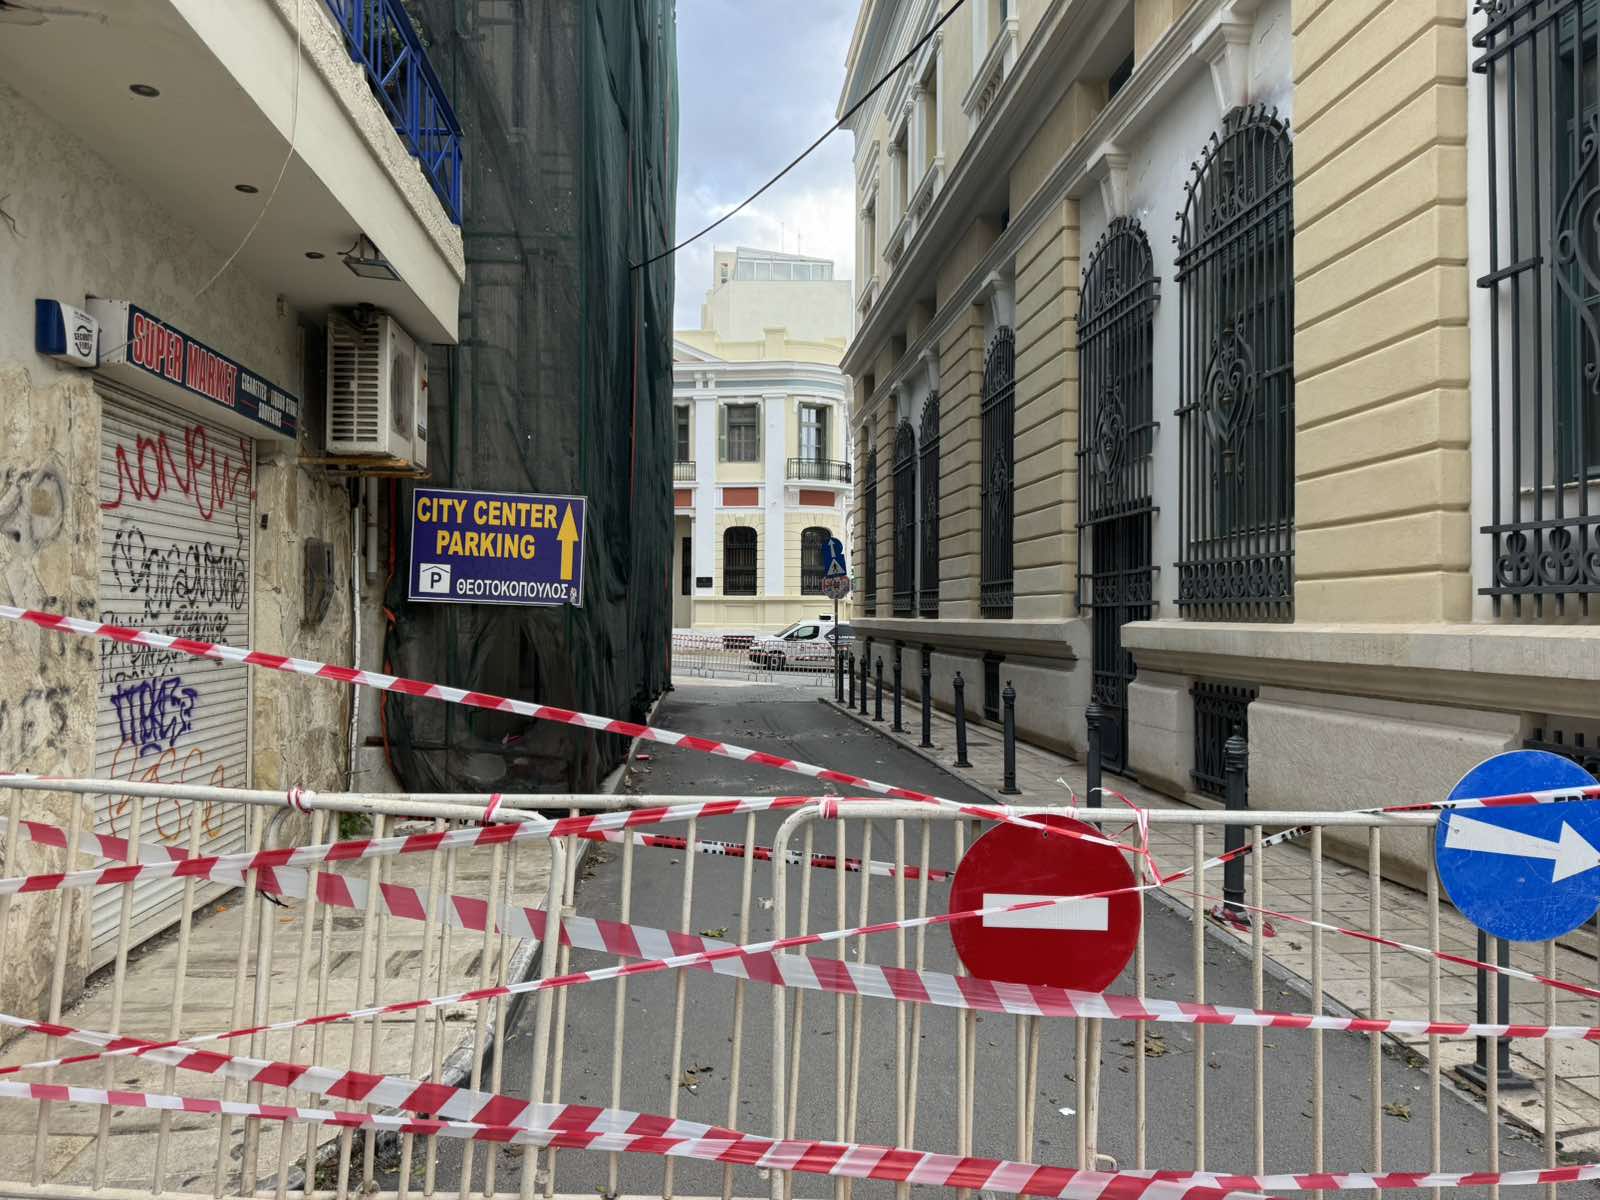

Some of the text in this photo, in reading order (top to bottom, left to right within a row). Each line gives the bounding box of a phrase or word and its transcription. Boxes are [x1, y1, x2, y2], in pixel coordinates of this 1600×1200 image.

[132, 312, 184, 384] SUPER
[186, 341, 238, 408] MARKET
[417, 496, 558, 529] CITY CENTER
[435, 530, 537, 560] PARKING
[430, 571, 442, 589] P
[456, 578, 569, 599] ΘΕΟΤΟΚΟΠΟΥΛΟΣ
